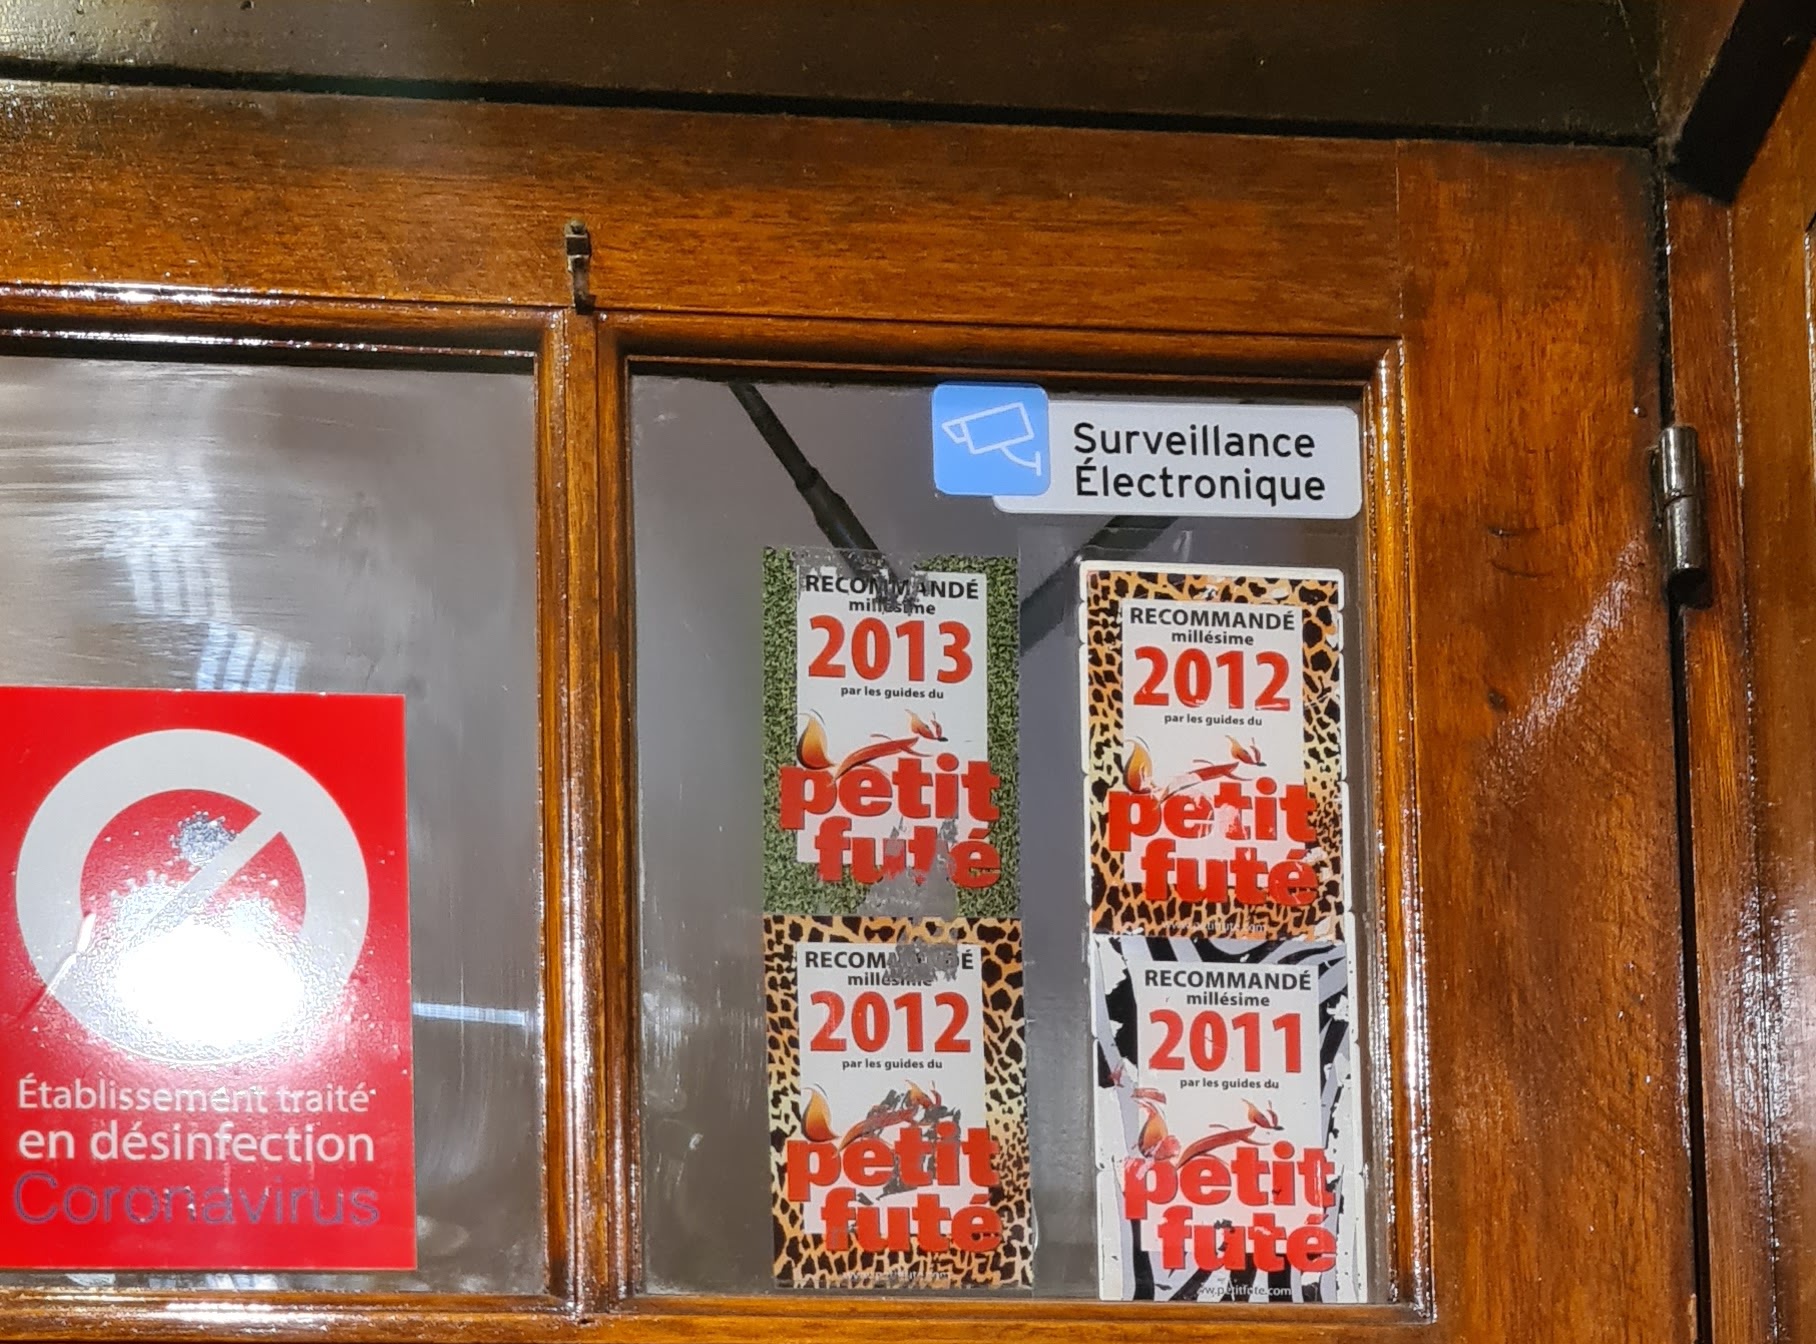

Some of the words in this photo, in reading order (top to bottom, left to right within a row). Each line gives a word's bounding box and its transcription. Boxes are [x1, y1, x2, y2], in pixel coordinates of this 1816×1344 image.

[1074, 422, 1315, 458] Surveillance
[1076, 457, 1326, 507] Électronique
[1130, 607, 1295, 631] RECOMMANDÉ
[1171, 630, 1254, 646] millésime
[809, 615, 973, 684] 2013
[841, 686, 862, 697] par
[865, 687, 882, 696] les
[885, 687, 925, 699] guides
[928, 689, 944, 699] du
[1133, 646, 1291, 712] 2012
[1164, 714, 1184, 725] par
[1186, 713, 1203, 723] les
[1205, 714, 1245, 726] guides
[1247, 715, 1262, 725] du
[779, 753, 1000, 830] petit
[1108, 777, 1317, 852] petit
[815, 816, 1000, 888] futé
[1142, 839, 1318, 906] futé
[1145, 969, 1312, 991] RECOMMANDÉ
[1186, 992, 1270, 1007] millésime
[810, 991, 971, 1053] 2012
[1148, 1009, 1302, 1073] 2011
[842, 1060, 862, 1070] par
[865, 1059, 881, 1069] les
[884, 1059, 924, 1071] guides
[927, 1059, 943, 1069] du
[1180, 1079, 1200, 1089] par
[1202, 1078, 1219, 1088] les
[1222, 1078, 1261, 1090] guides
[1264, 1079, 1279, 1089] du
[18, 1074, 266, 1113] Établissement
[276, 1083, 370, 1113] traité
[18, 1130, 74, 1159] en
[90, 1121, 374, 1162] désinfection
[787, 1121, 1000, 1201] petit
[14, 1173, 379, 1225] Coronavirus
[1124, 1141, 1336, 1220] petit
[821, 1188, 1001, 1252] futé
[1158, 1205, 1337, 1272] futé
